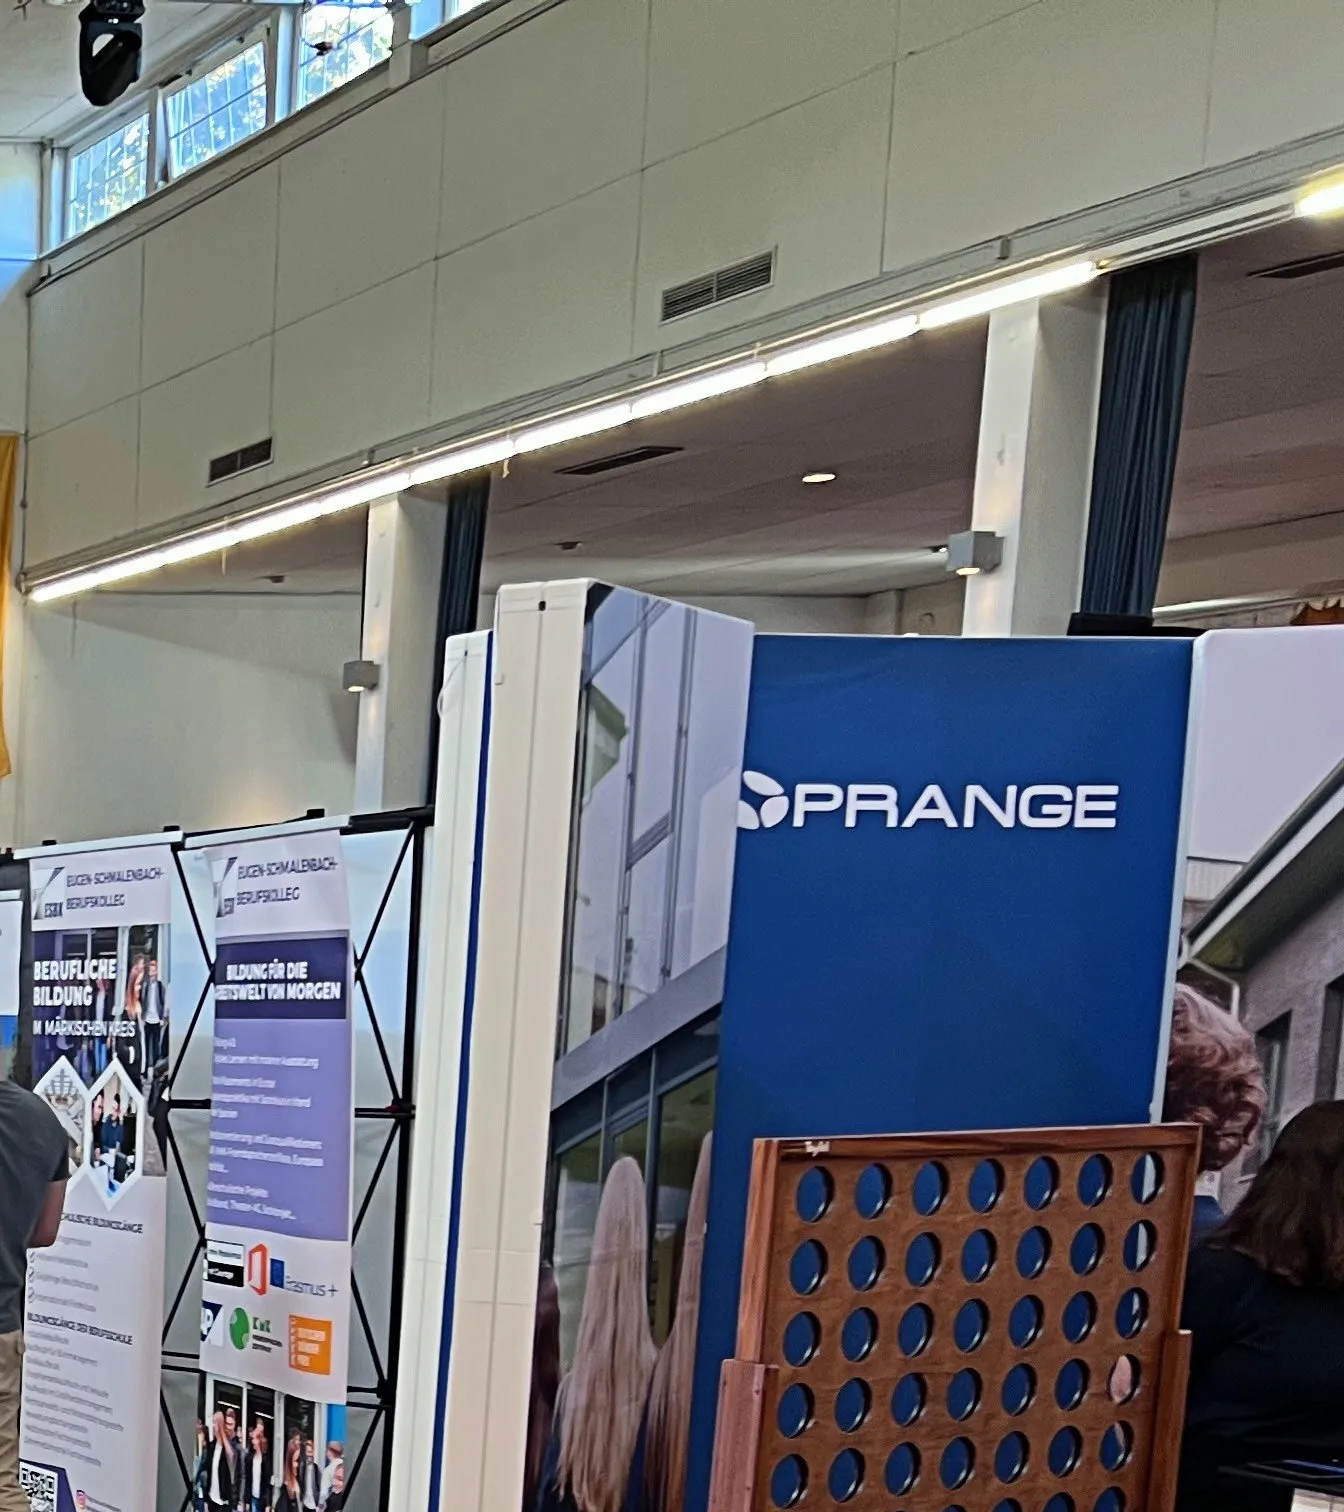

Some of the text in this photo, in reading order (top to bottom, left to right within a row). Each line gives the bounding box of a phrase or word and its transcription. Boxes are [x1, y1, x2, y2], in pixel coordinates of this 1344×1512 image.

[793, 784, 1119, 828] PRANGE
[33, 958, 117, 981] BERUFLICHE
[286, 961, 308, 979] DIE
[33, 985, 93, 1007] BILDUNG
[286, 981, 342, 1000] MORGEN
[44, 1016, 108, 1036] MÄRKISCHEN
